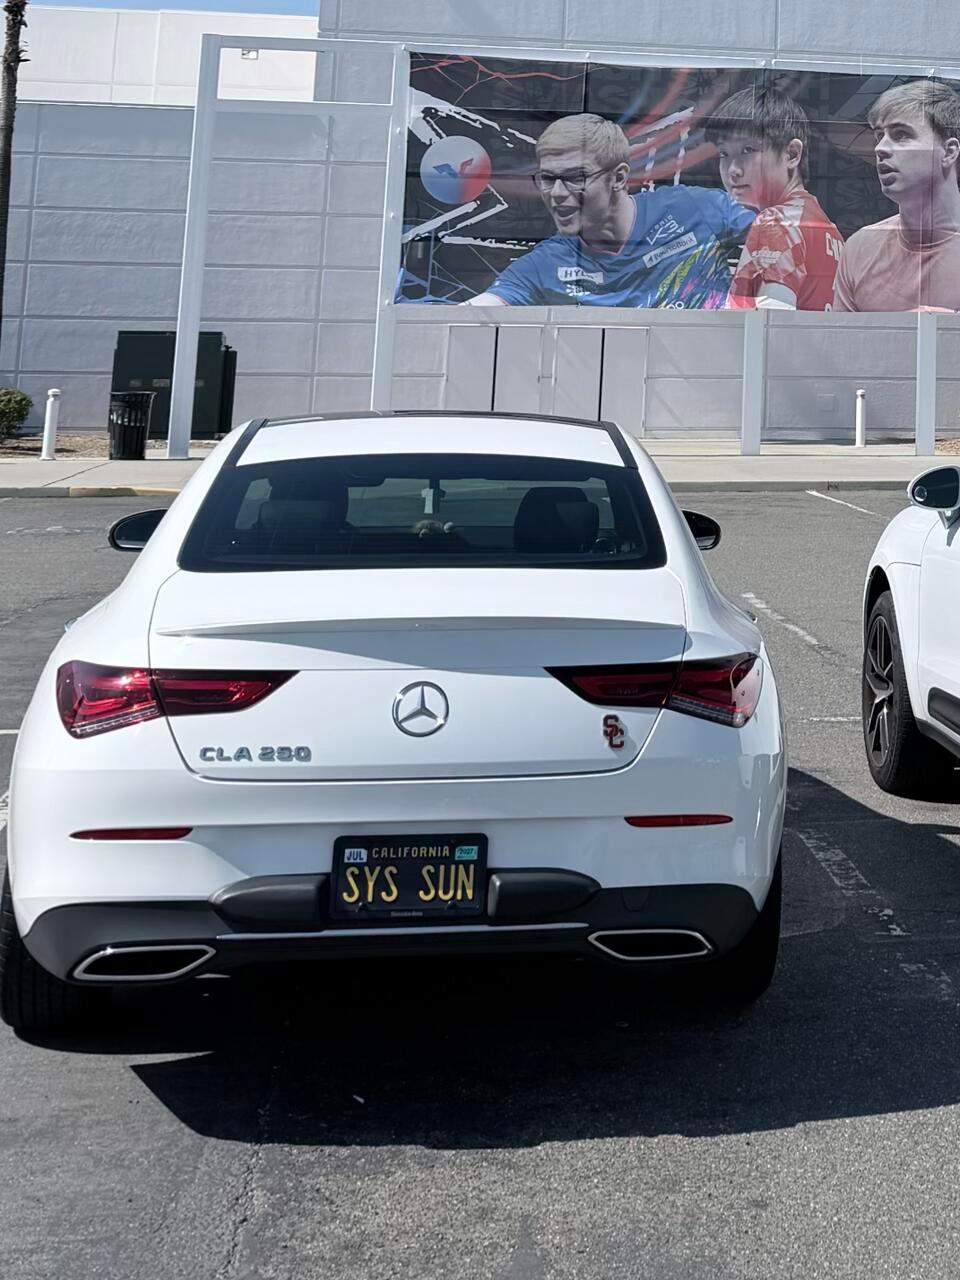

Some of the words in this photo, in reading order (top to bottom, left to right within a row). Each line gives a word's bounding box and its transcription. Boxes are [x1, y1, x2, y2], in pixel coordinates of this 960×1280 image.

[199, 746, 253, 762] CLA
[346, 849, 365, 862] JUL
[371, 846, 450, 859] CALIFORNIA
[342, 865, 399, 903] SYS
[418, 864, 476, 902] SUN
